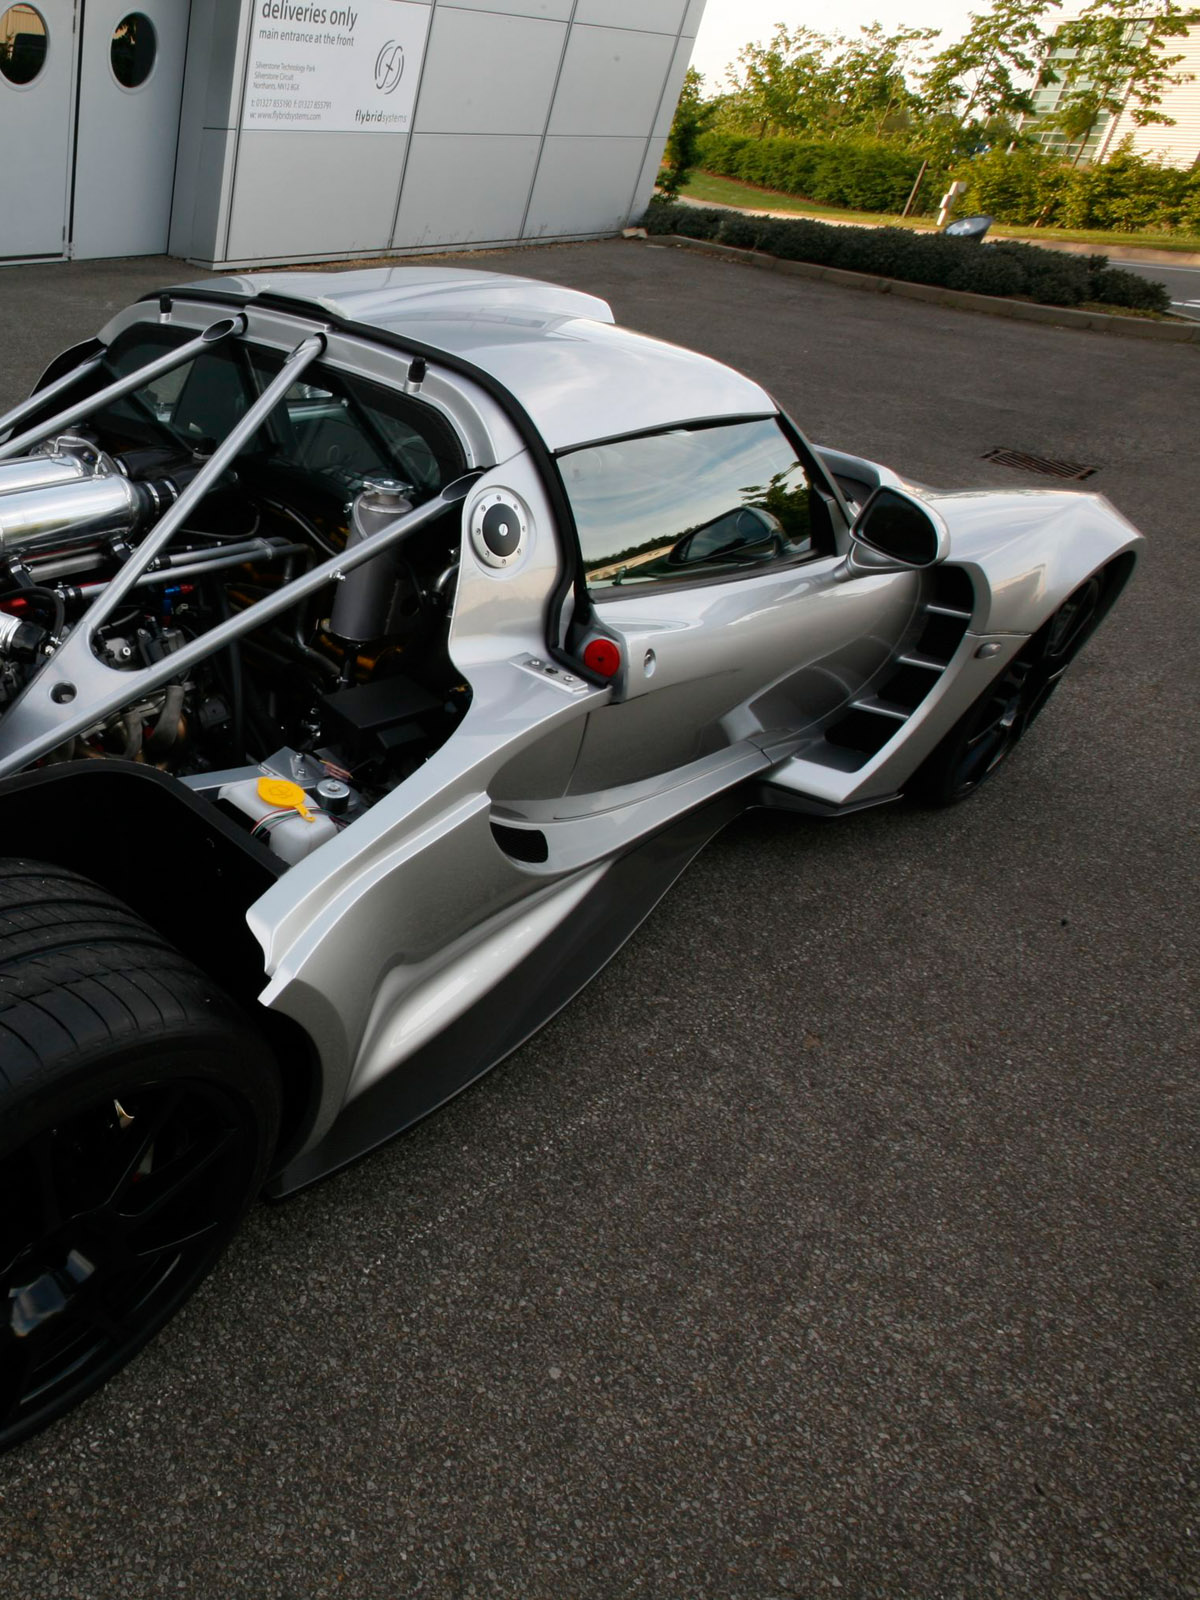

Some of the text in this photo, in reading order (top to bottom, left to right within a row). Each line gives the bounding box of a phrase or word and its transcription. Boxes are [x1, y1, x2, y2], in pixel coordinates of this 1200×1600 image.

[262, 0, 358, 32] deliveries only
[259, 28, 355, 46] main entrance at the front
[255, 61, 280, 70] Silverstone
[254, 72, 279, 80] Silverstone
[257, 110, 321, 122] www.flybridsystems.com
[355, 109, 407, 125] flybridsystems
